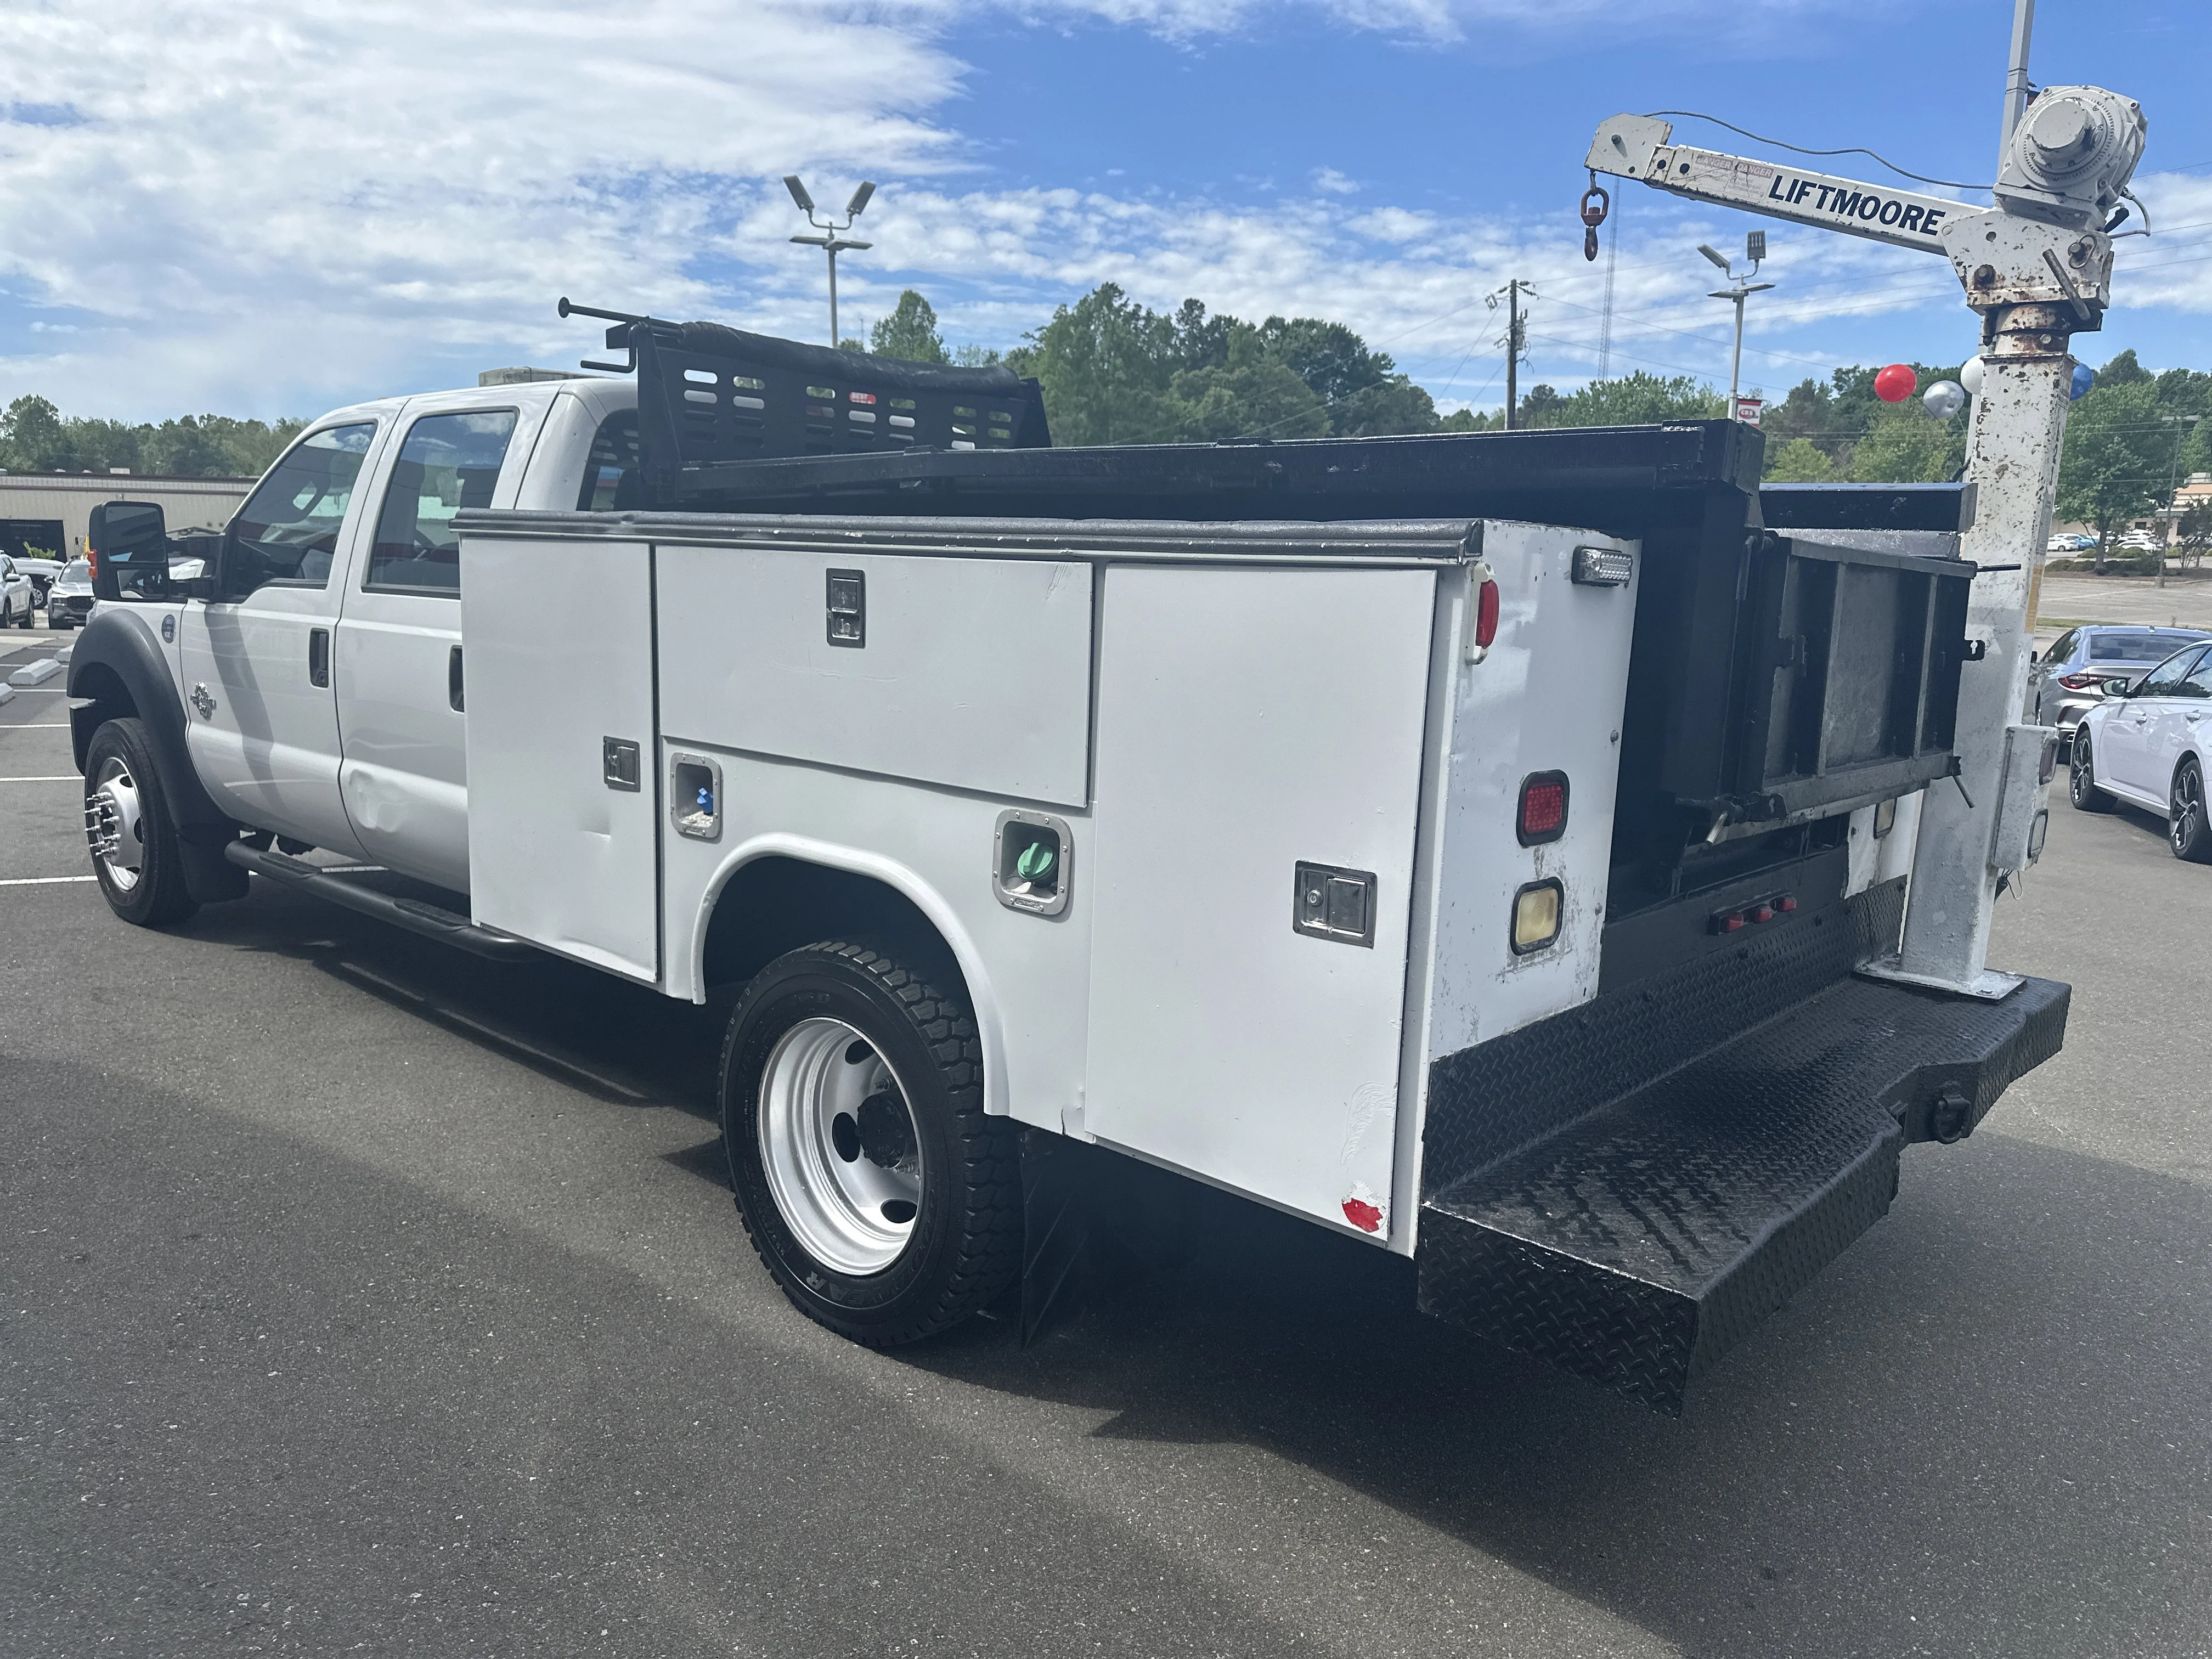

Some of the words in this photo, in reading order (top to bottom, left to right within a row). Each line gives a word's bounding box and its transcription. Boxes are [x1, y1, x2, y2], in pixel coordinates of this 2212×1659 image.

[1696, 156, 1731, 168] DANGER
[1737, 164, 1771, 177] DANGER
[1768, 175, 1946, 236] LIFTMOORE
